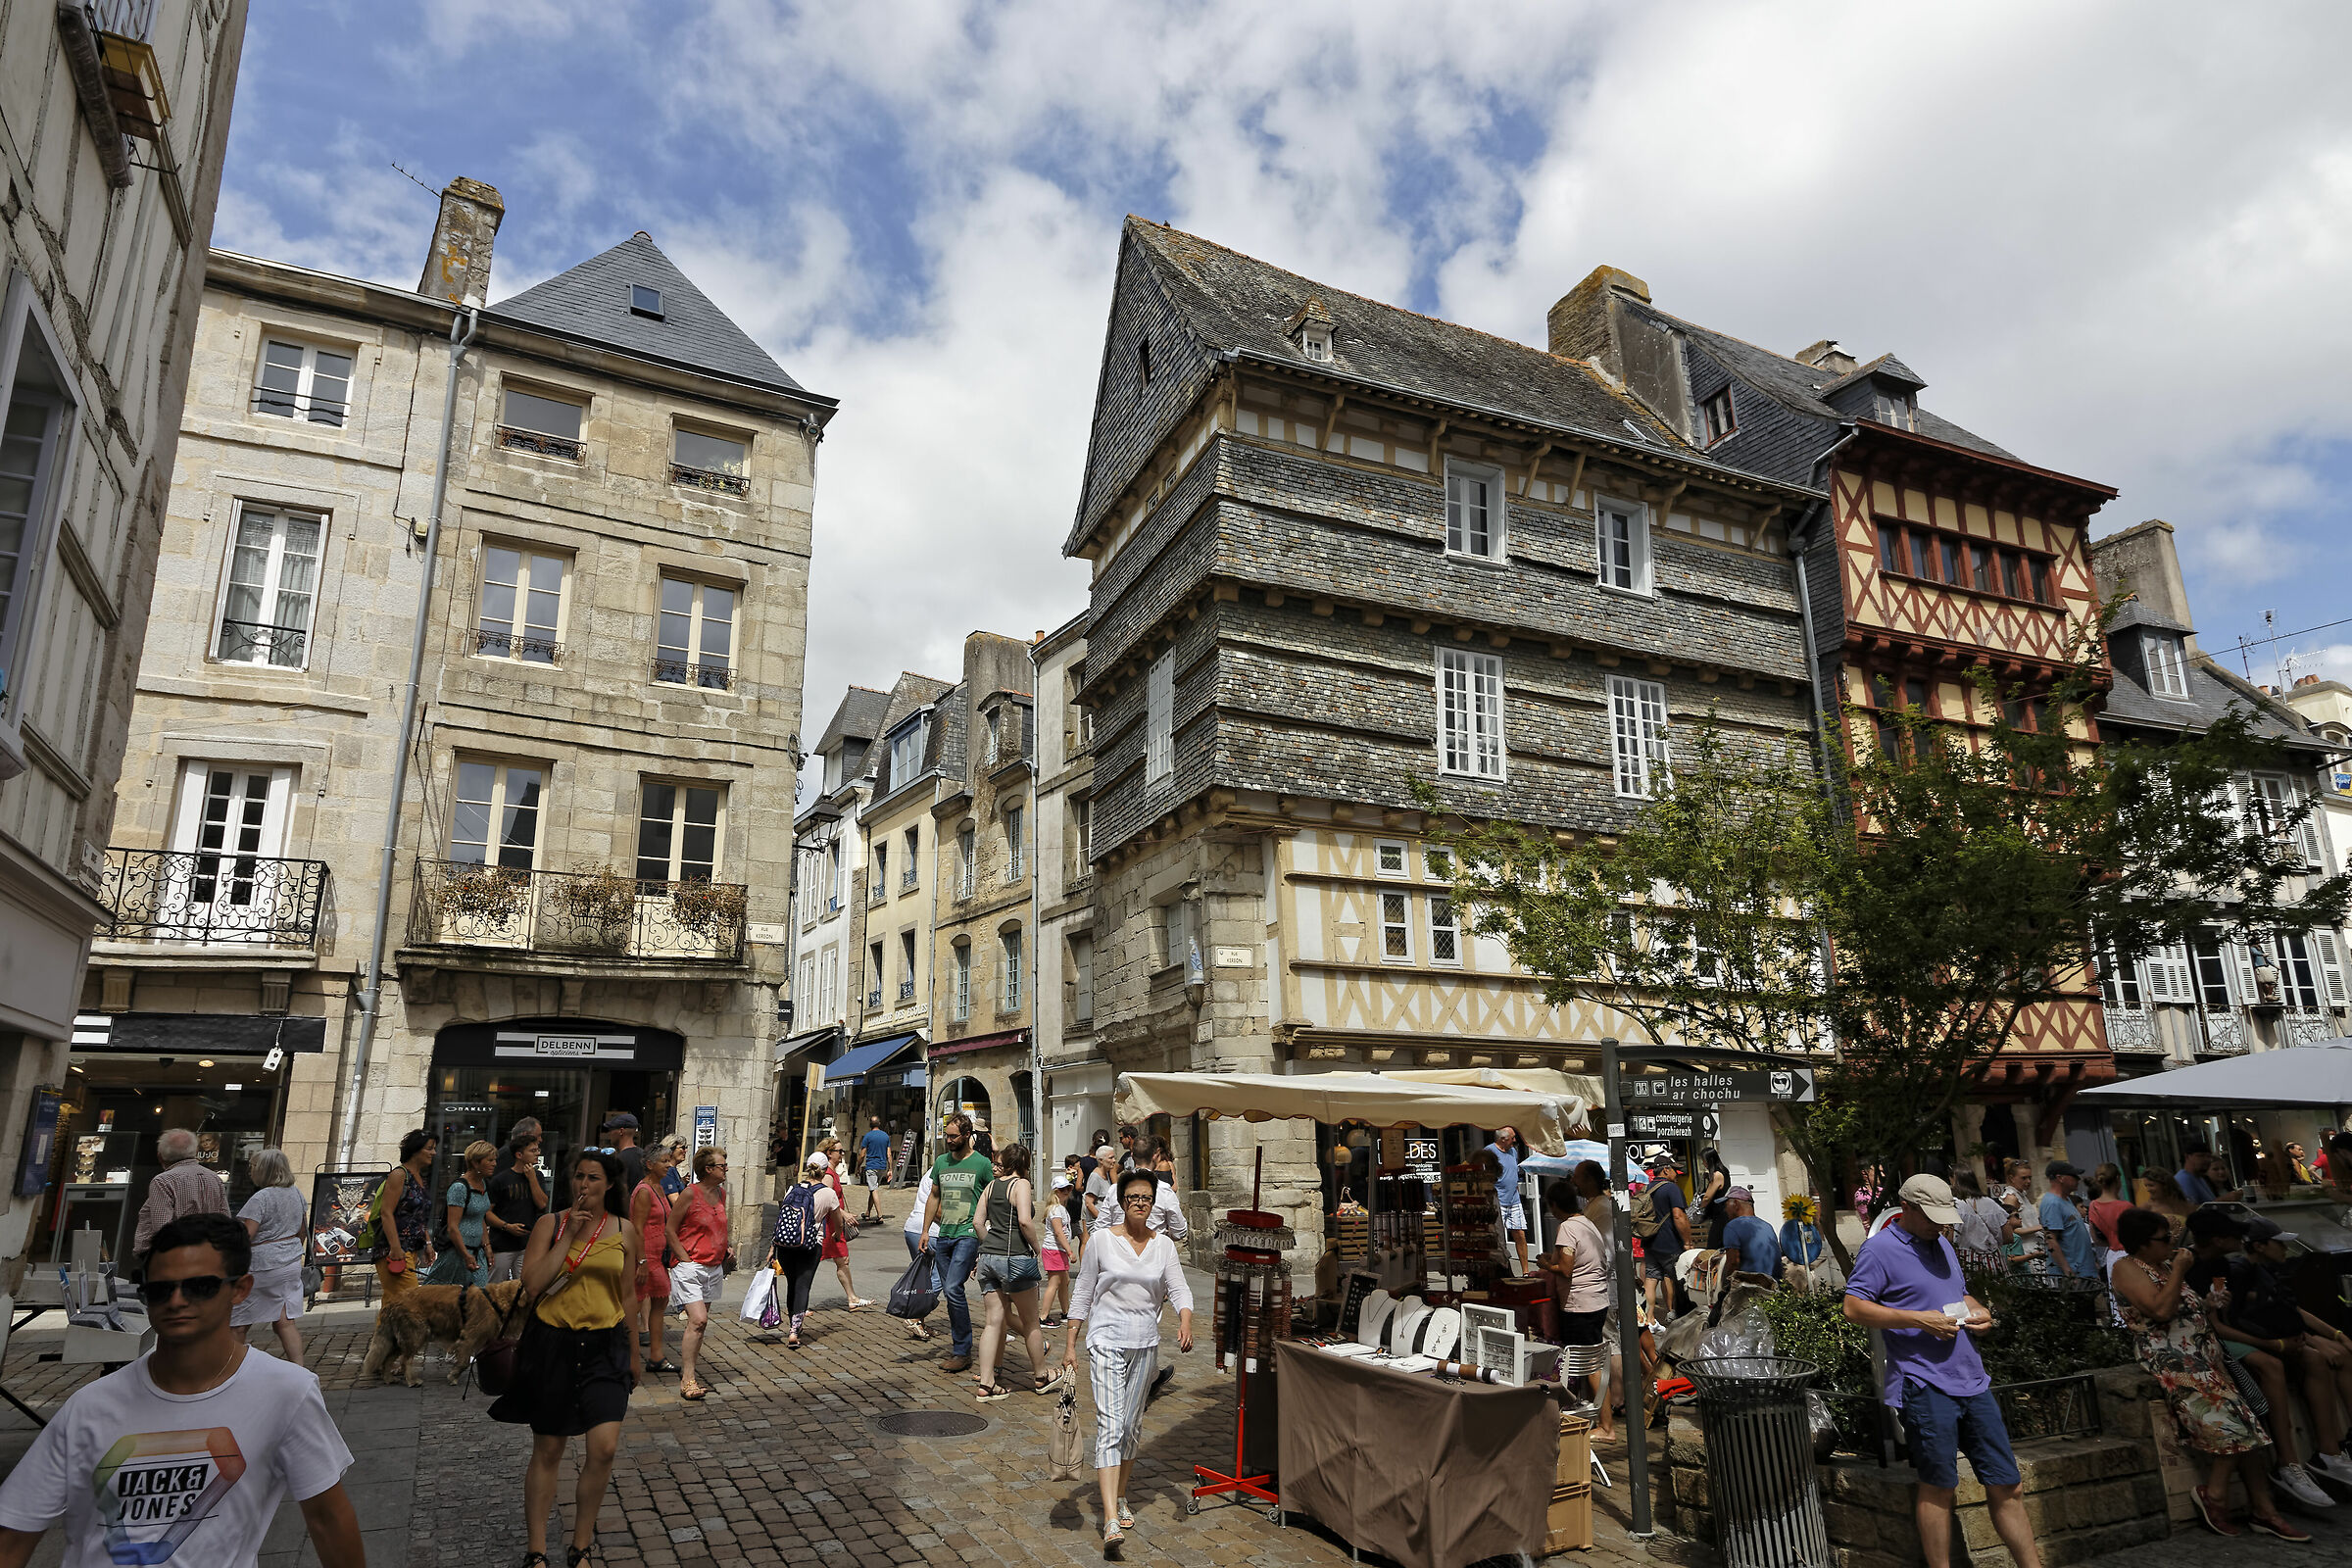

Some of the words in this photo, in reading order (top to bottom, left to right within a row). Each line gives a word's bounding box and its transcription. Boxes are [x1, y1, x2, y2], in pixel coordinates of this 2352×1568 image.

[541, 1041, 591, 1050] DELBENN
[1670, 1075, 1688, 1087] les
[1693, 1074, 1733, 1087] halles
[1672, 1091, 1686, 1100] ar
[1655, 1113, 1692, 1126] conciergerie
[1656, 1126, 1692, 1139] porzhierezh
[121, 1466, 203, 1495] JACK&
[117, 1493, 197, 1521] JONES
